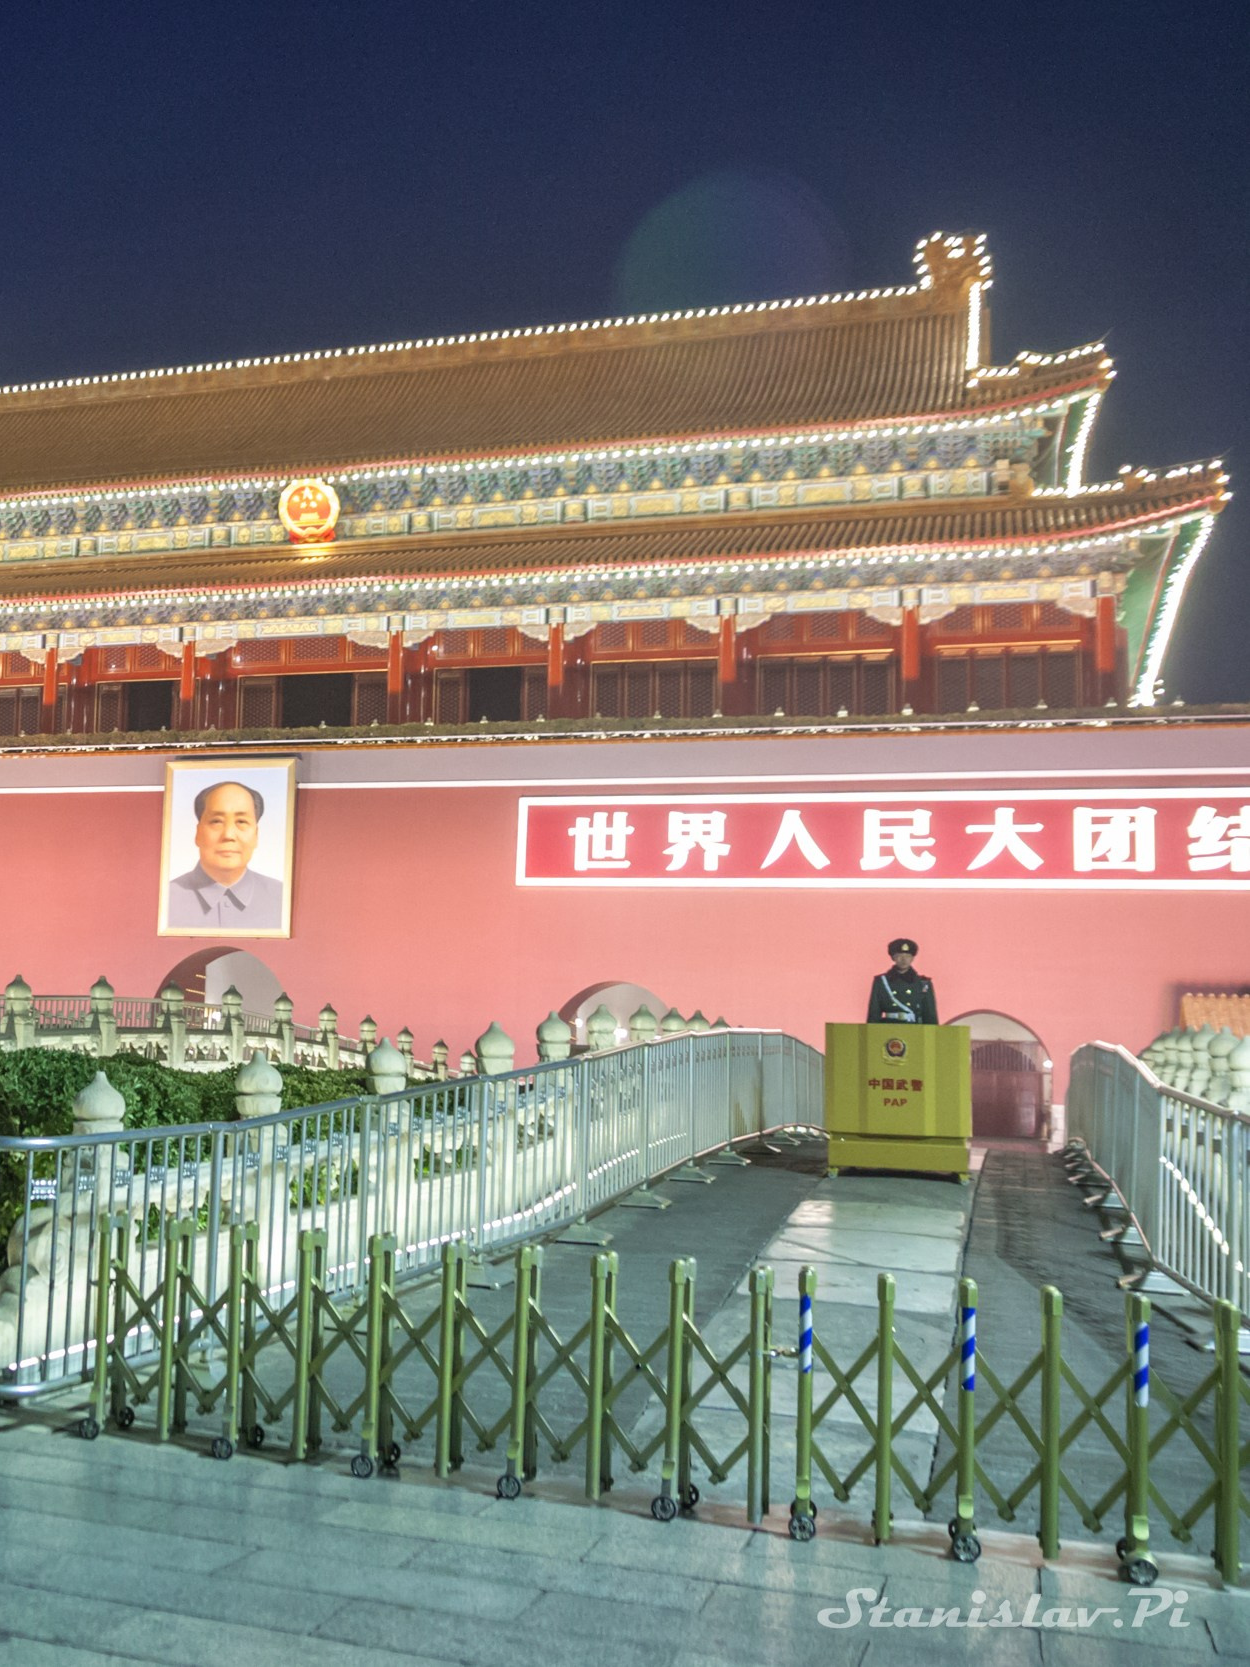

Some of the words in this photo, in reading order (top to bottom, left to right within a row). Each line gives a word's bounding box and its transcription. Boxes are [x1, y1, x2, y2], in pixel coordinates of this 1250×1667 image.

[567, 805, 1250, 872] 世界人民大团结
[868, 1078, 923, 1092] 中国武警
[883, 1098, 907, 1107] PAP
